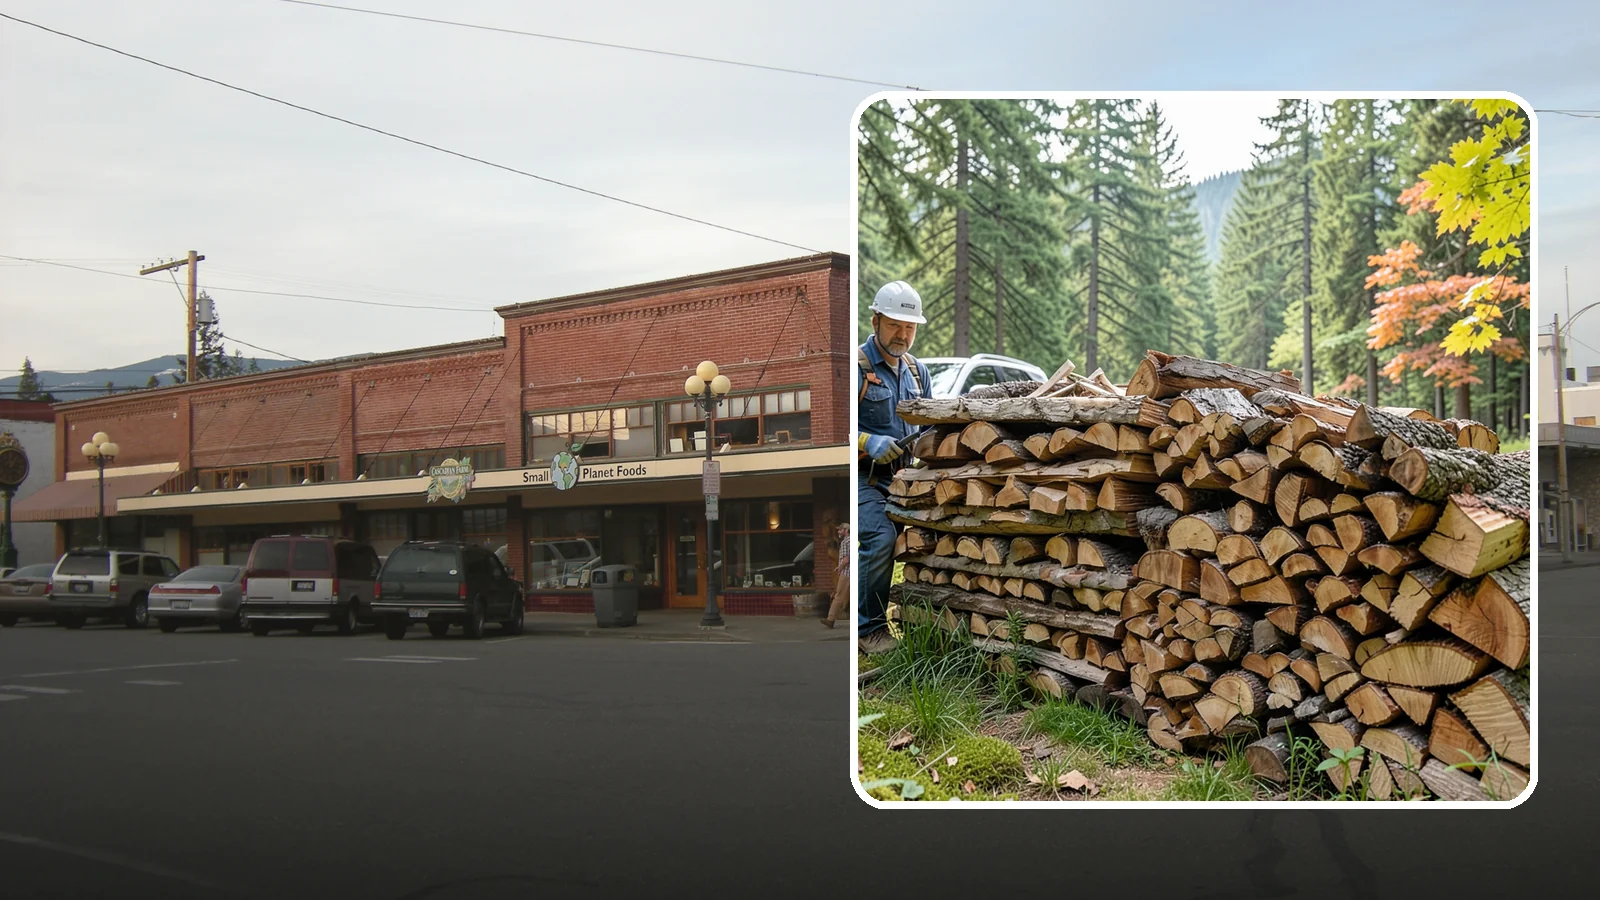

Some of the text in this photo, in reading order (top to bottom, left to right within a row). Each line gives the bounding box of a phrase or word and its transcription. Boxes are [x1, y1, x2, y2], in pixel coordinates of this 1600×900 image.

[523, 464, 647, 483] Small Planet Foods
